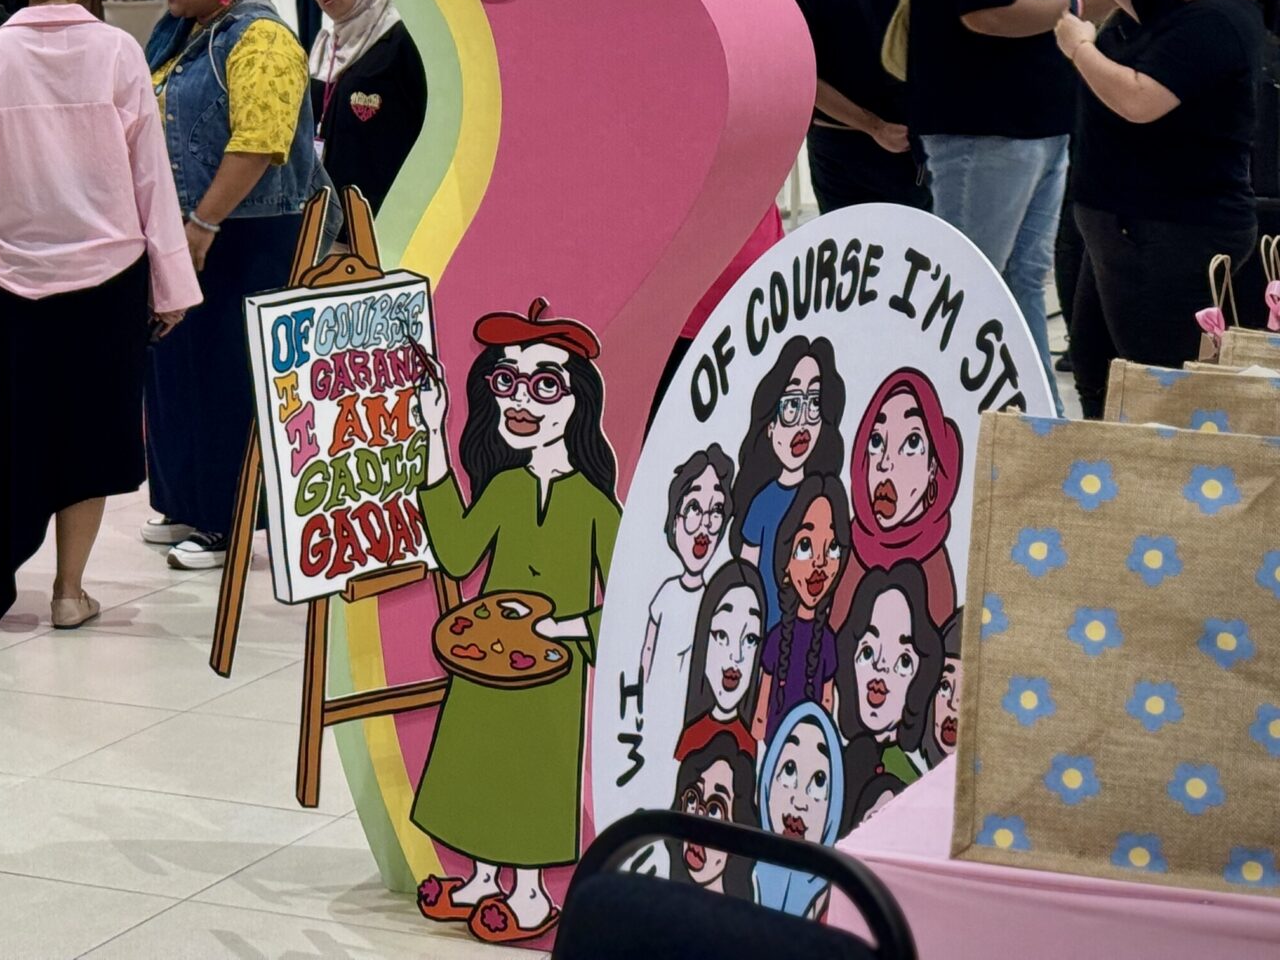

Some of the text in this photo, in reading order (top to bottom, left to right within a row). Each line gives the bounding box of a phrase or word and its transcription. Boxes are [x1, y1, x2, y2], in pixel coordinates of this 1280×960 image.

[271, 291, 425, 373] OF COURSE
[689, 325, 738, 422] OF
[744, 237, 884, 358] COURSE
[888, 246, 966, 337] I'M
[286, 389, 418, 477] I AM
[295, 430, 427, 517] GADIS
[300, 492, 424, 580] GADAN
